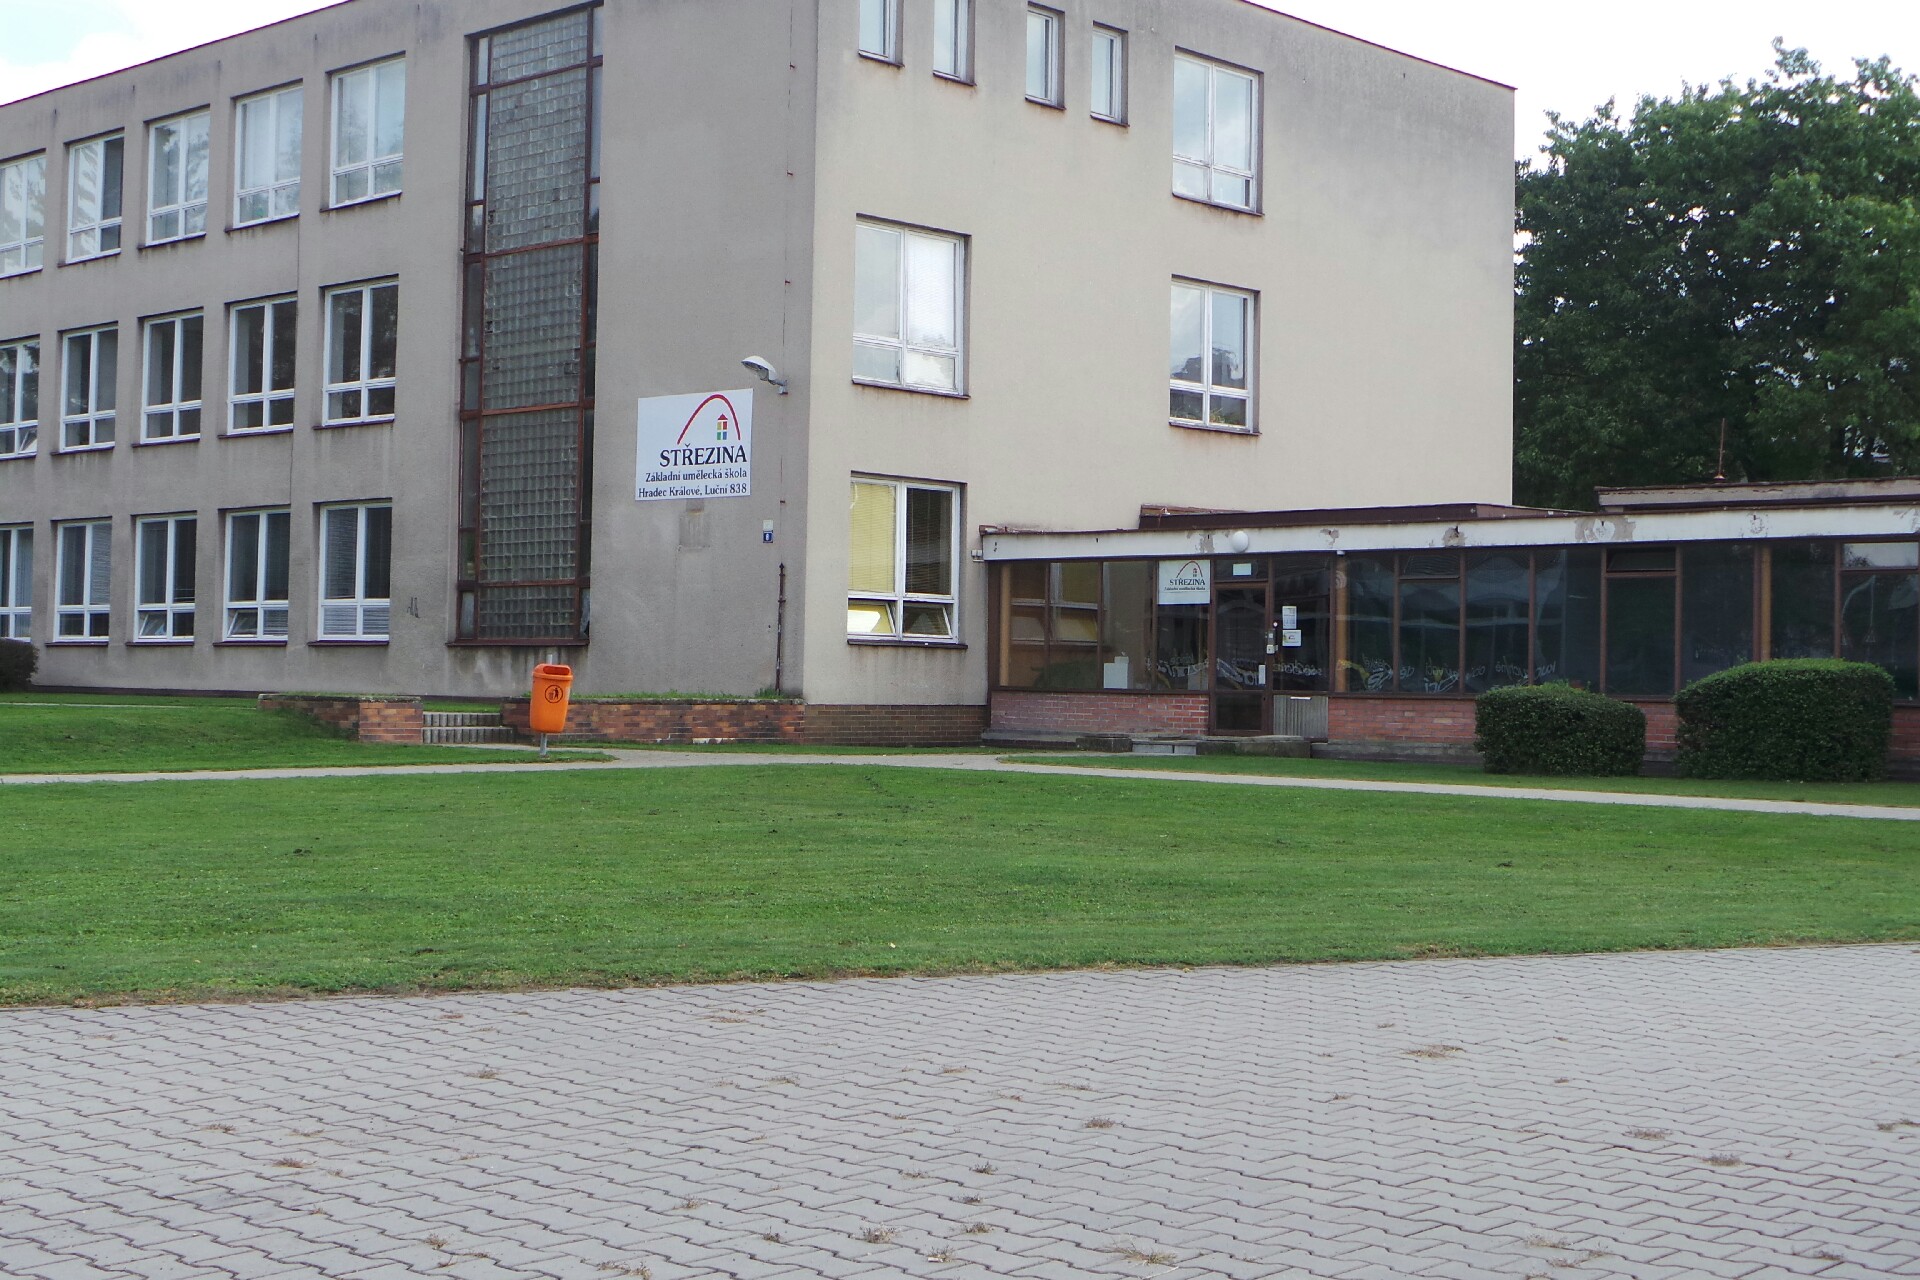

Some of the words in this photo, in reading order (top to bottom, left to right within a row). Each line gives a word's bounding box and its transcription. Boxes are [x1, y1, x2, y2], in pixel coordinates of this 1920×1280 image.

[659, 443, 747, 467] STŘEZINA
[645, 470, 680, 483] Základní
[682, 468, 722, 481] umělecká
[724, 467, 747, 479] škola
[638, 486, 667, 498] Hradec
[669, 485, 702, 497] Králové,
[704, 483, 728, 496] Luční
[729, 482, 747, 494] 838
[1169, 577, 1206, 586] STŘEZINA
